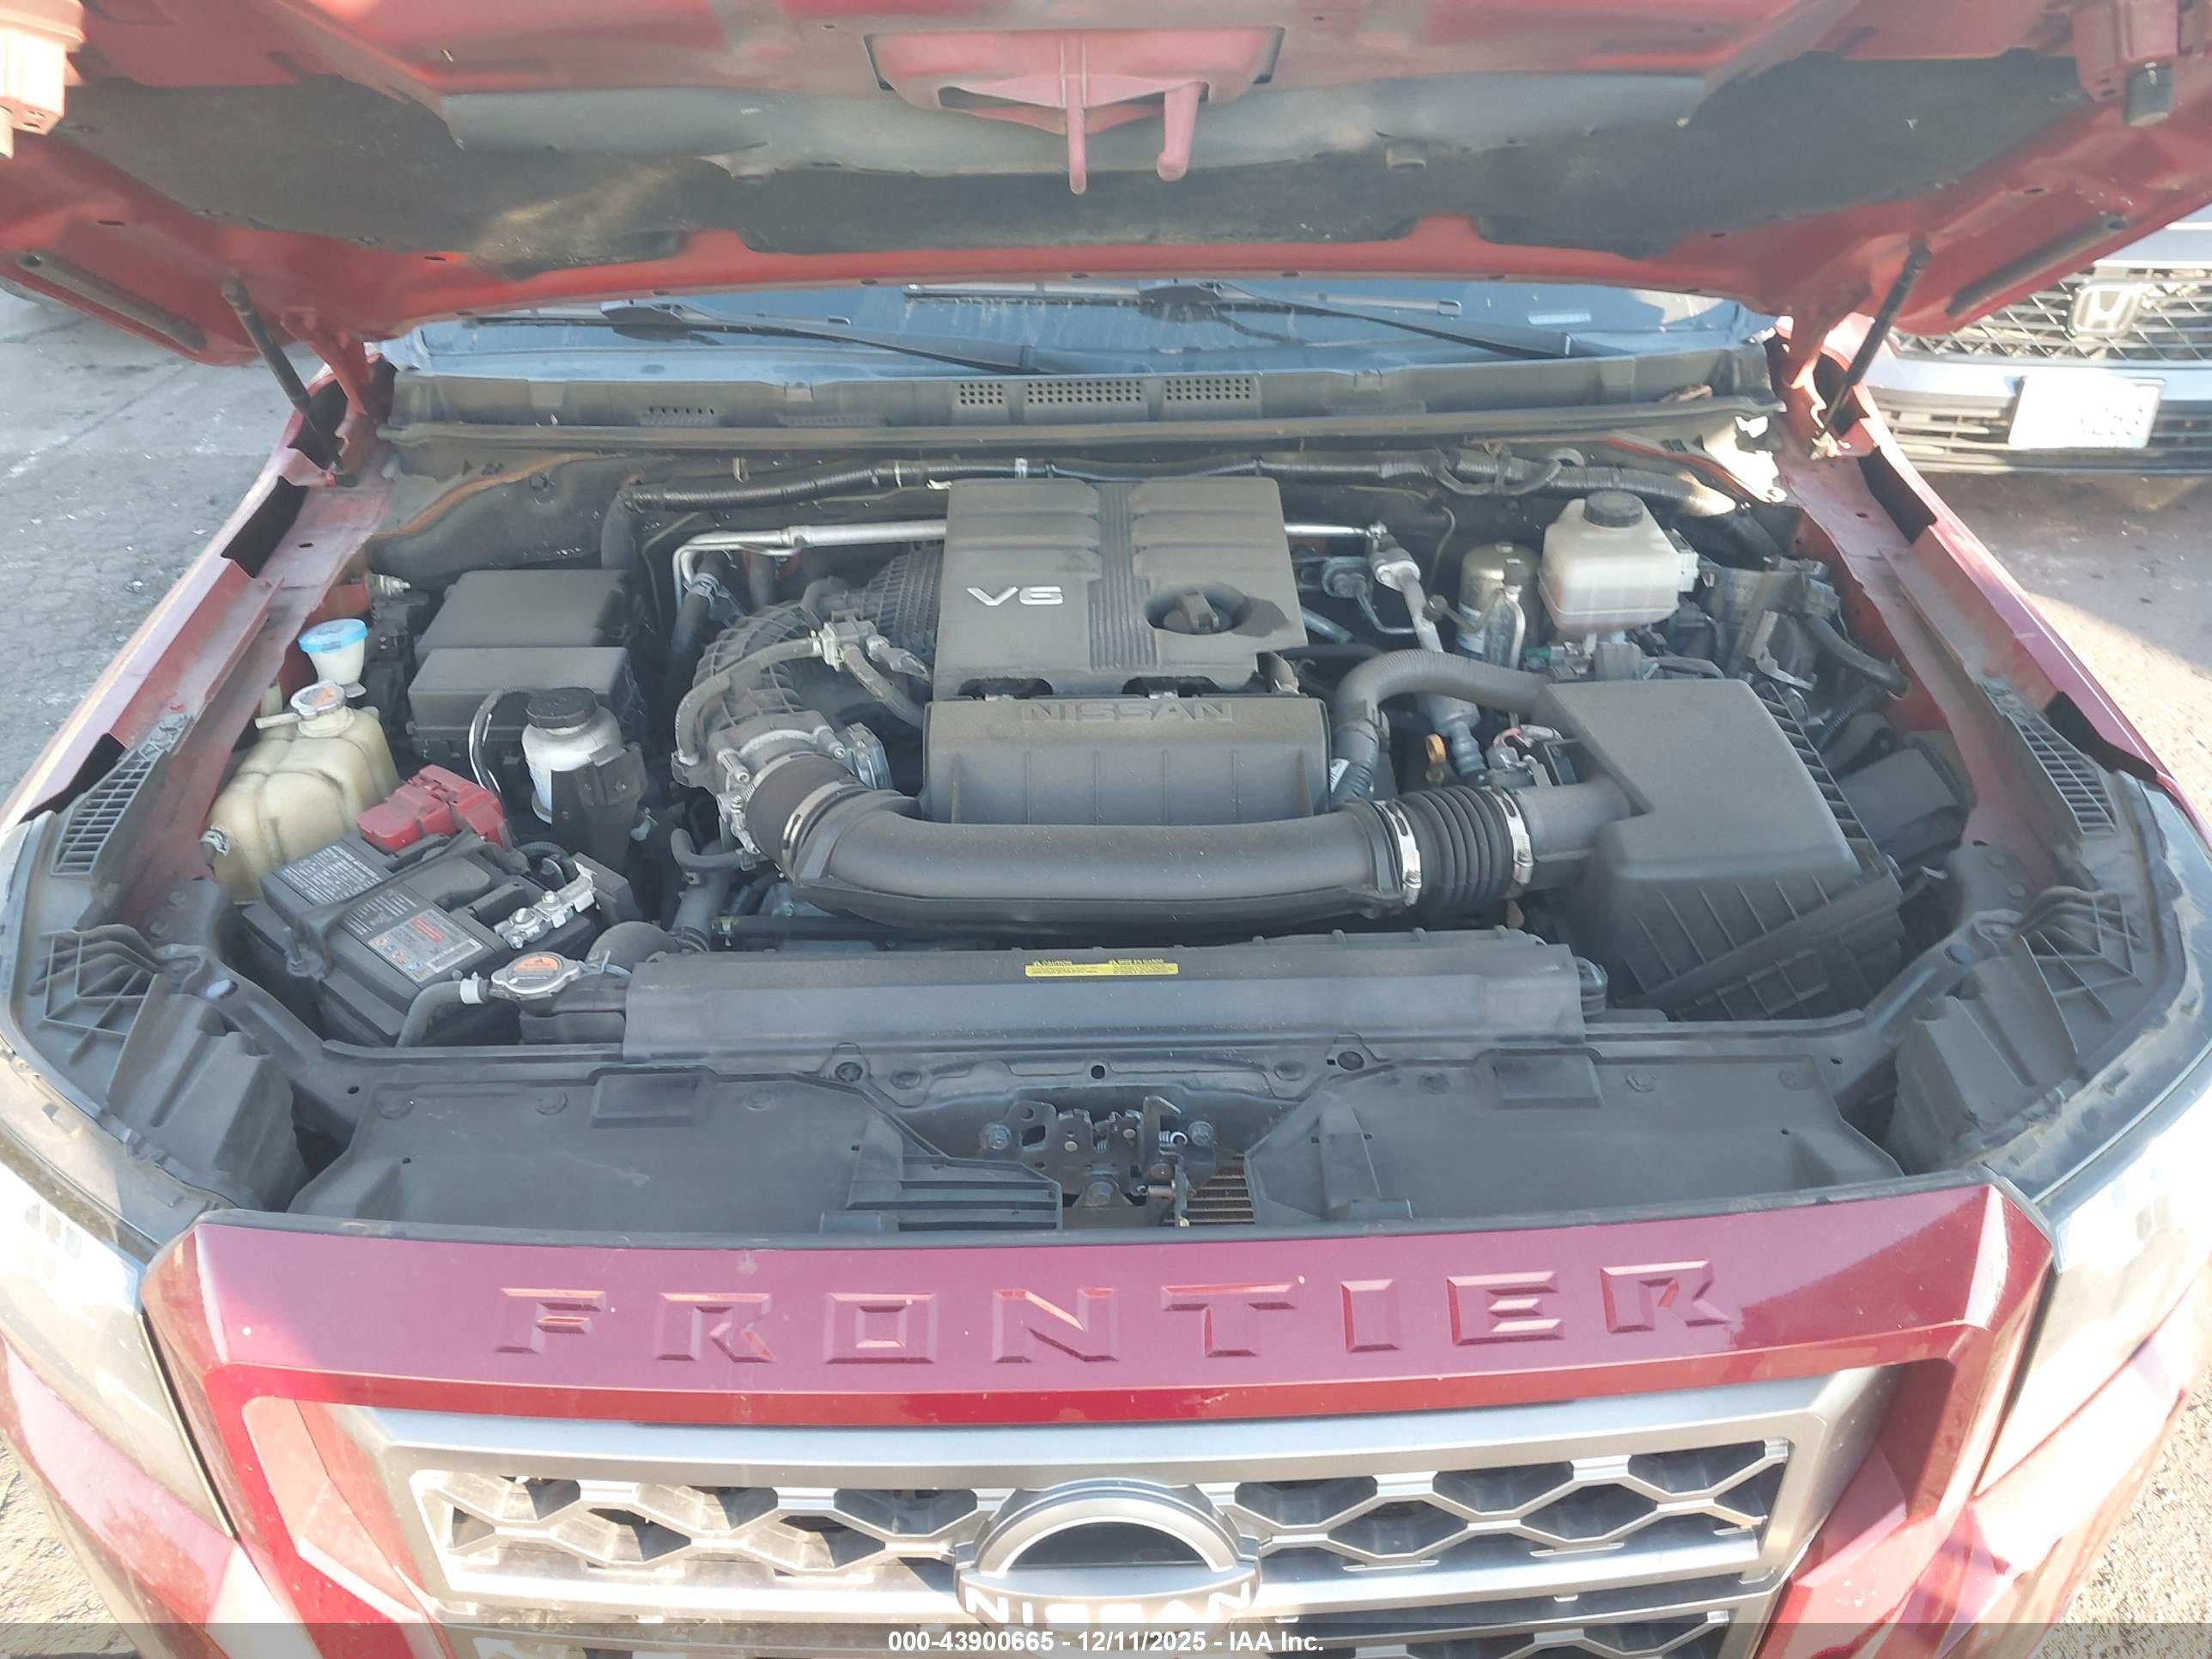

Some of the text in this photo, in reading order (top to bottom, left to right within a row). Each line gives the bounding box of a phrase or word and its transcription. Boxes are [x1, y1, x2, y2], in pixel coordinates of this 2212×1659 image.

[966, 586, 1064, 606] V6
[1021, 701, 1234, 722] NISSAN
[494, 1259, 1732, 1364] FRONTIER
